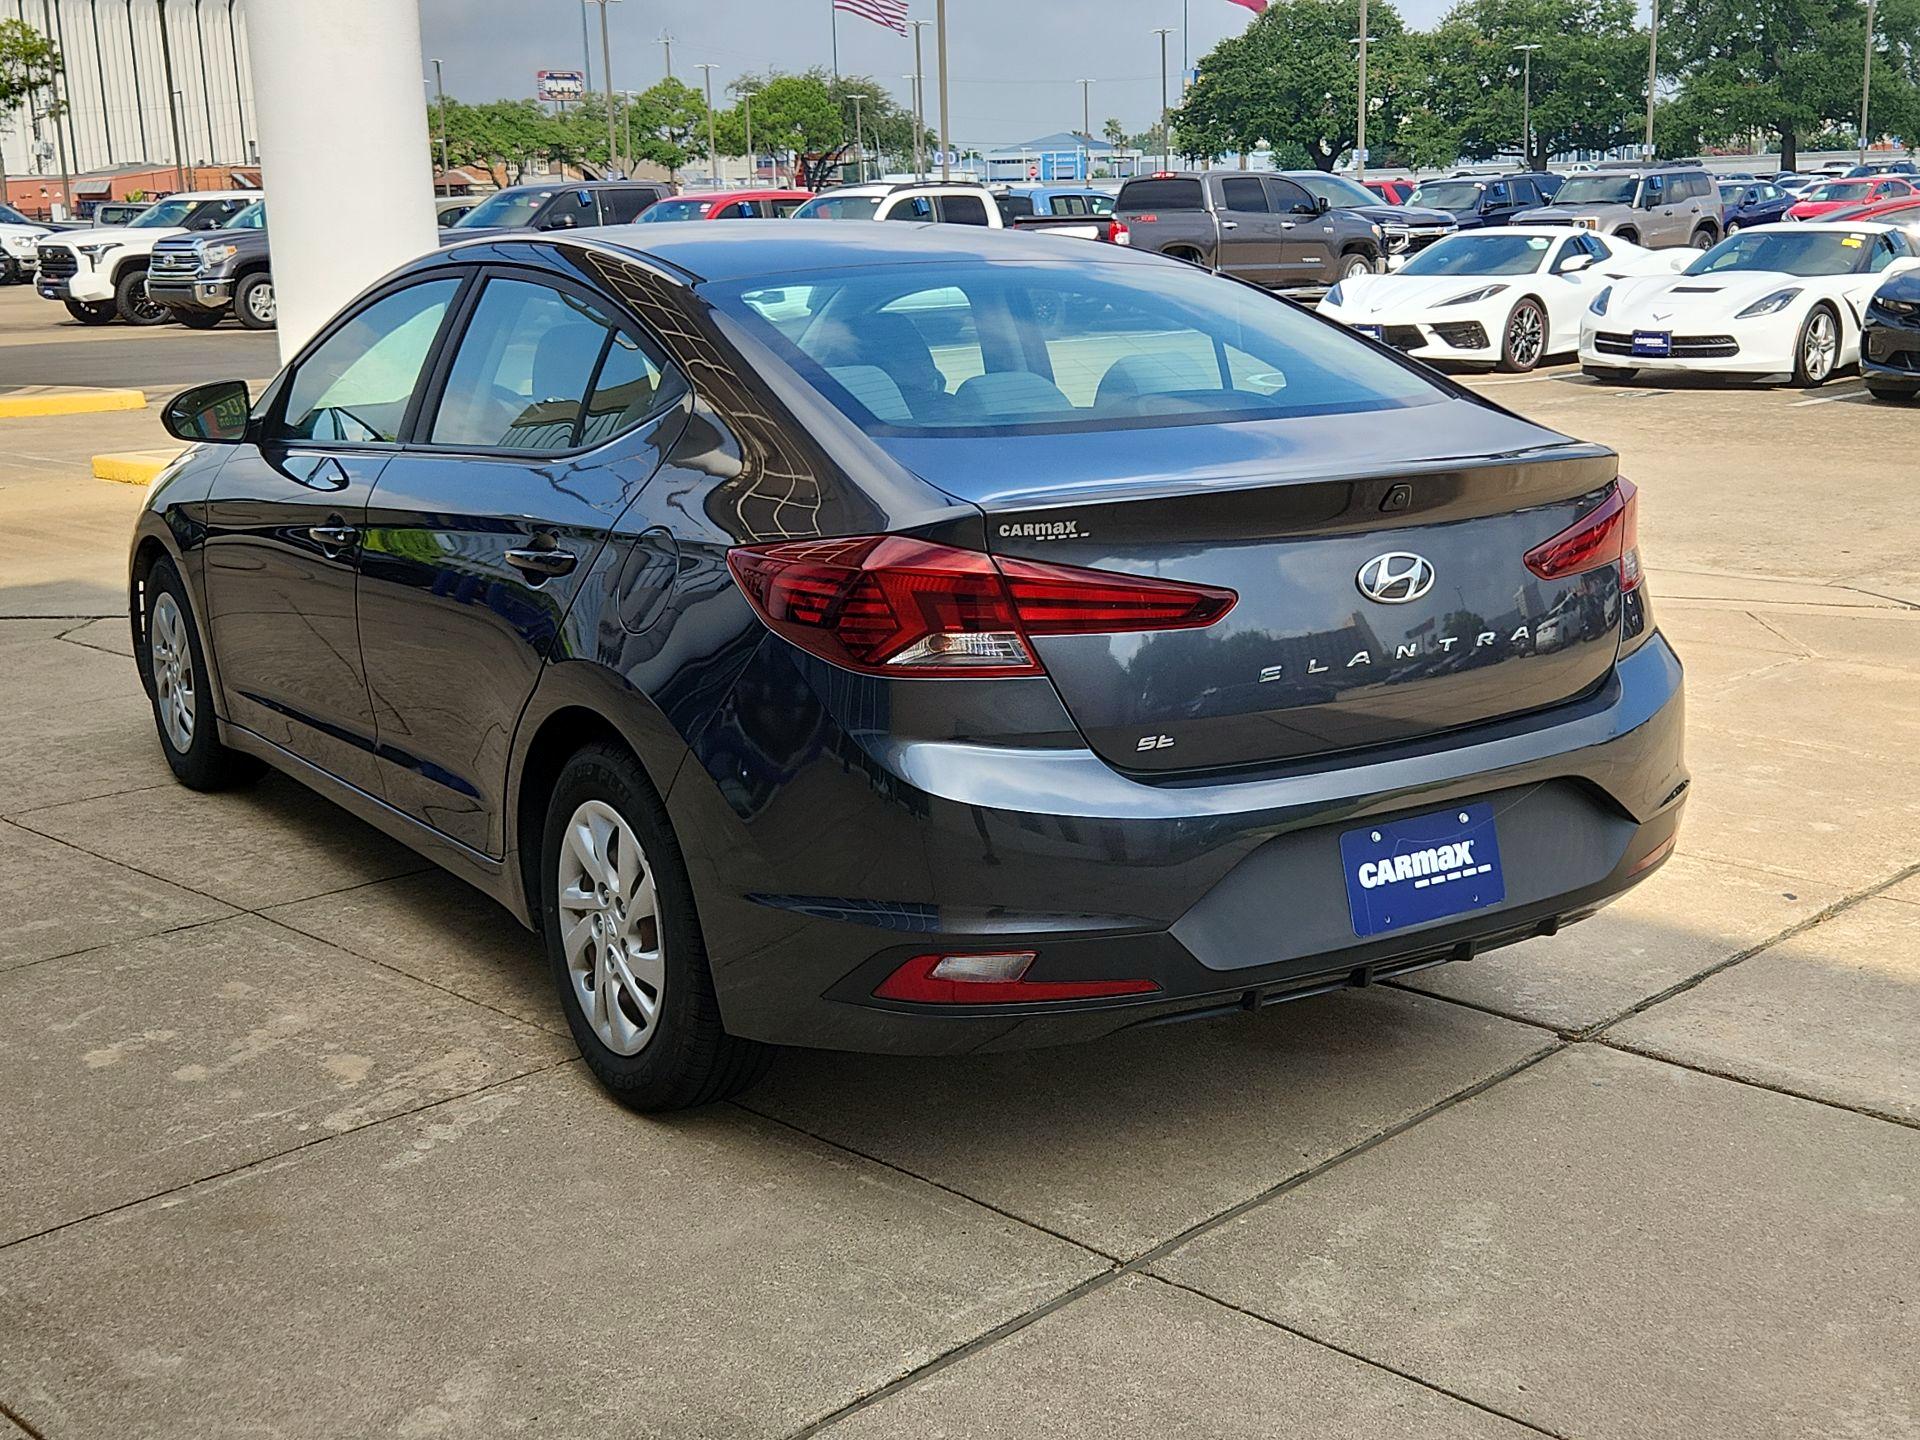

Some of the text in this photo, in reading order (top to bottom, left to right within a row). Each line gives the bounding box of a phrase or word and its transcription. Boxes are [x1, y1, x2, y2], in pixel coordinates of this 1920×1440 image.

[1258, 625, 1530, 683] ELANTRA
[1136, 734, 1175, 752] SE
[1358, 839, 1475, 889] CARmax
